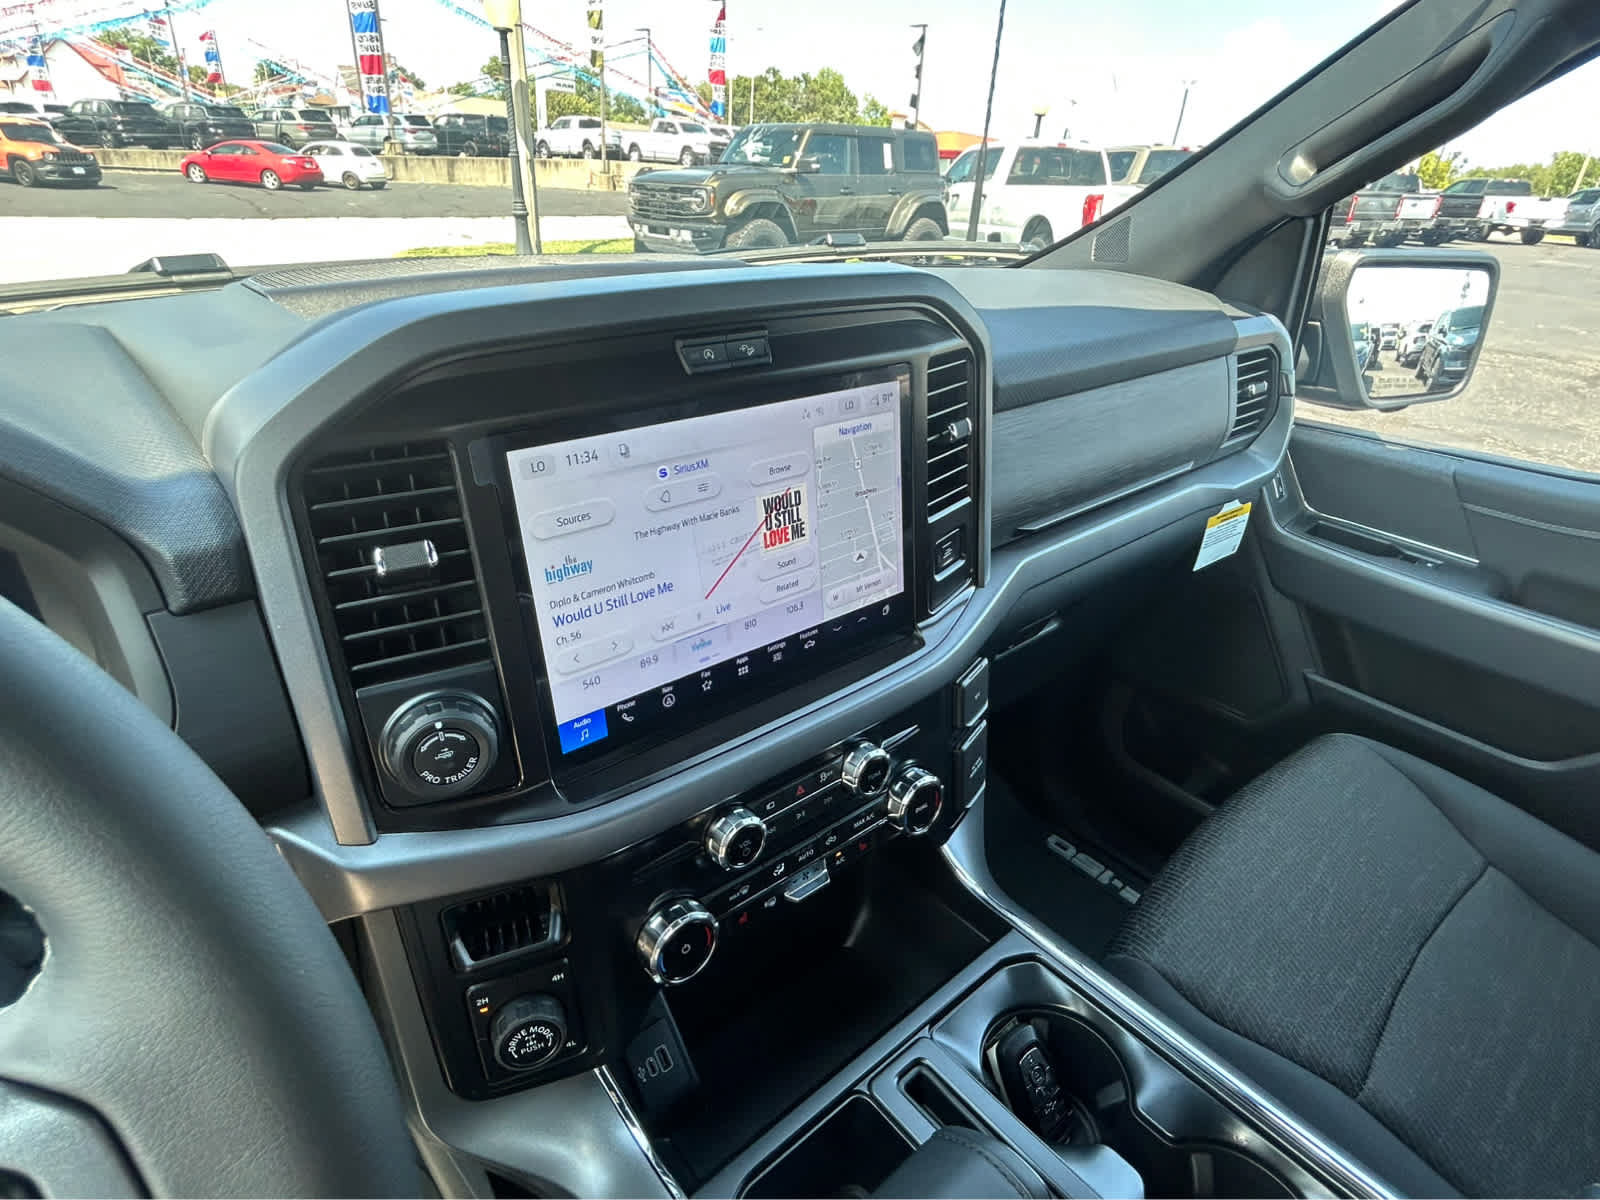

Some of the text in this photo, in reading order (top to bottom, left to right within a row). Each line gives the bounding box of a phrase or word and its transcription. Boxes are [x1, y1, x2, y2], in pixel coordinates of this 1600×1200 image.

[845, 400, 854, 410] LO
[839, 422, 873, 436] Navigation
[566, 449, 599, 467] 11:34
[530, 460, 546, 473] LO
[674, 459, 709, 475] SiriusXM
[768, 463, 792, 476] Browse
[762, 489, 802, 515] WOULD
[556, 512, 592, 528] Sources
[634, 529, 651, 541] The
[650, 523, 681, 537] Highway
[681, 517, 698, 529] With
[720, 505, 741, 518] Banks
[764, 509, 802, 532] U STILL
[763, 526, 790, 549] LOVE
[791, 522, 806, 541] ME
[565, 554, 578, 566] the
[777, 557, 797, 569] Sound
[544, 560, 593, 583] highway
[550, 571, 656, 609] Diplo & Cameron Whitcomb
[776, 579, 799, 593] Related
[552, 581, 674, 628] Would U Still Love Me
[716, 602, 731, 615] Live
[786, 600, 804, 615] 106.3
[570, 632, 582, 641] 56
[640, 654, 659, 668] 89.9
[582, 675, 601, 690] 540
[617, 700, 636, 712] Phone
[573, 718, 592, 729] Audio
[420, 756, 478, 784] PRO TRAILER
[551, 972, 565, 982] 4H
[476, 997, 489, 1007] 2H
[508, 1025, 555, 1053] DRIVE MODE
[565, 1040, 577, 1048] 4L
[520, 1042, 545, 1055] PUSH
